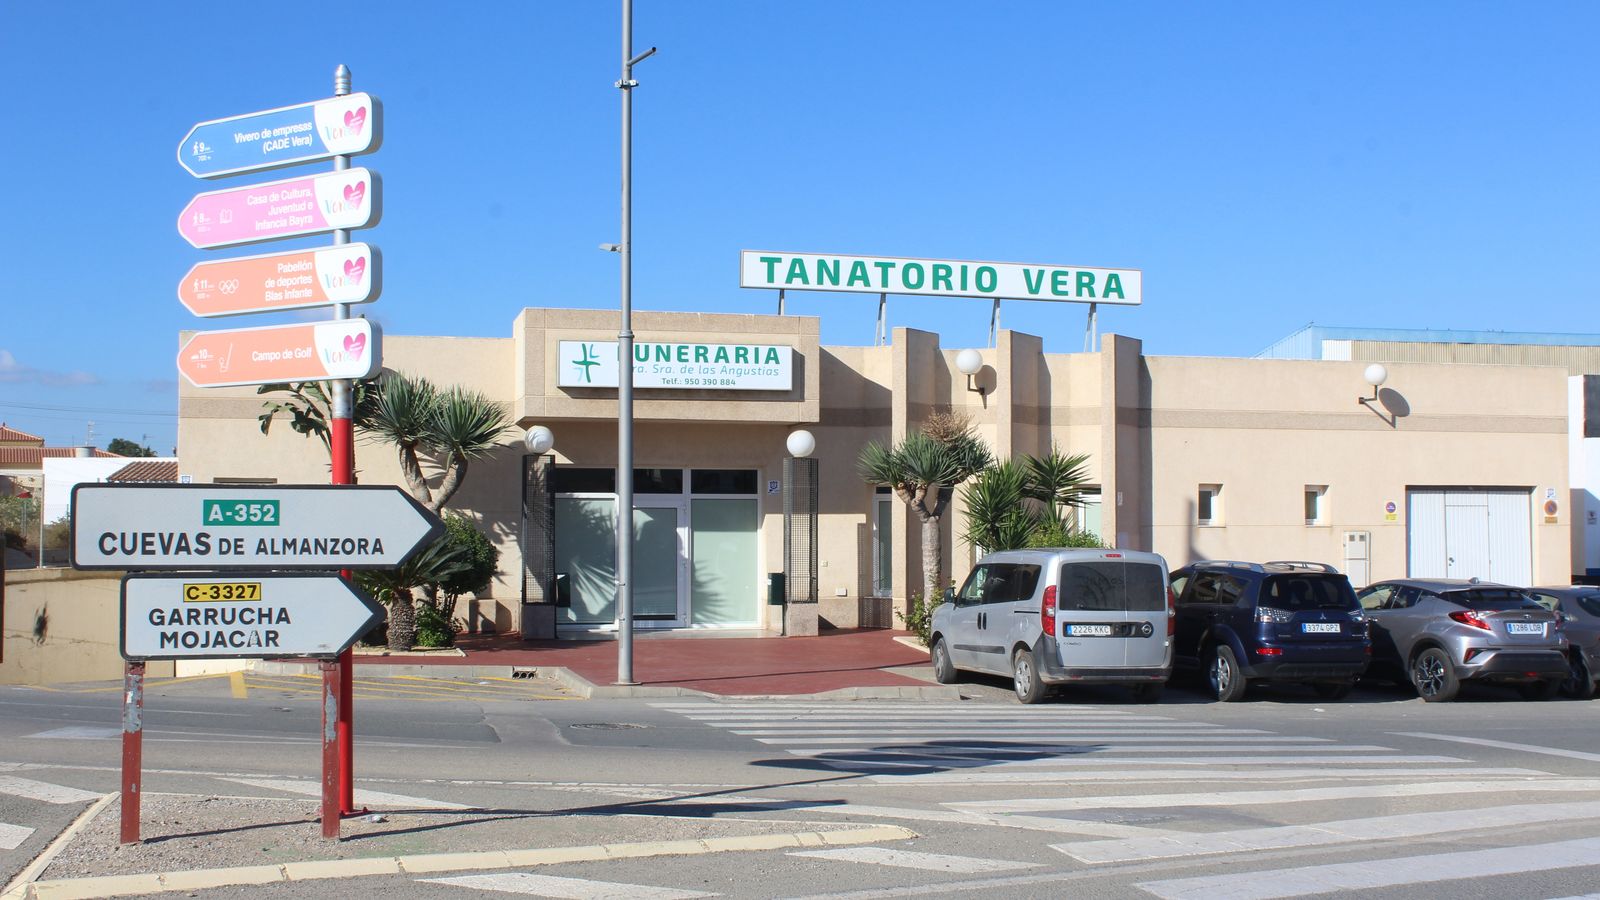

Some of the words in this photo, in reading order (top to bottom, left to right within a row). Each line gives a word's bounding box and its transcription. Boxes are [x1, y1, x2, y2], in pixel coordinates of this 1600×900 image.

[234, 132, 260, 144] Vivero
[261, 128, 272, 139] de
[272, 122, 312, 137] empresas
[263, 137, 290, 154] (CADE
[291, 133, 313, 147] Vera)
[247, 195, 268, 205] Casa
[269, 192, 280, 202] de
[268, 201, 306, 215] Juventud
[307, 202, 313, 210] e
[256, 218, 288, 231] Infancia
[277, 260, 312, 273] Pabellón
[265, 277, 275, 288] de
[277, 275, 312, 288] deportes
[759, 256, 998, 294] TANATORIO
[1023, 268, 1125, 299] VERA
[265, 291, 283, 301] Blas
[284, 288, 312, 299] Infante
[252, 351, 281, 362] Campo
[282, 349, 293, 359] de
[295, 347, 312, 358] Golf
[618, 344, 780, 364] UNERARIA
[652, 364, 675, 374] Sra.
[680, 365, 694, 374] de
[698, 364, 716, 375] las
[720, 365, 779, 377] Angustias
[684, 377, 700, 385] 950
[702, 378, 717, 386] 390
[720, 378, 736, 386] 884
[208, 504, 275, 522] A-352
[98, 532, 211, 556] CUEVAS
[219, 538, 245, 555] DE
[255, 538, 385, 555] ALMANZORA
[186, 585, 257, 600] C-3327
[148, 607, 291, 626] GARRUCHA
[1073, 625, 1093, 634] 2226
[1094, 625, 1110, 634] KKC
[160, 630, 280, 649] MOJACAR
